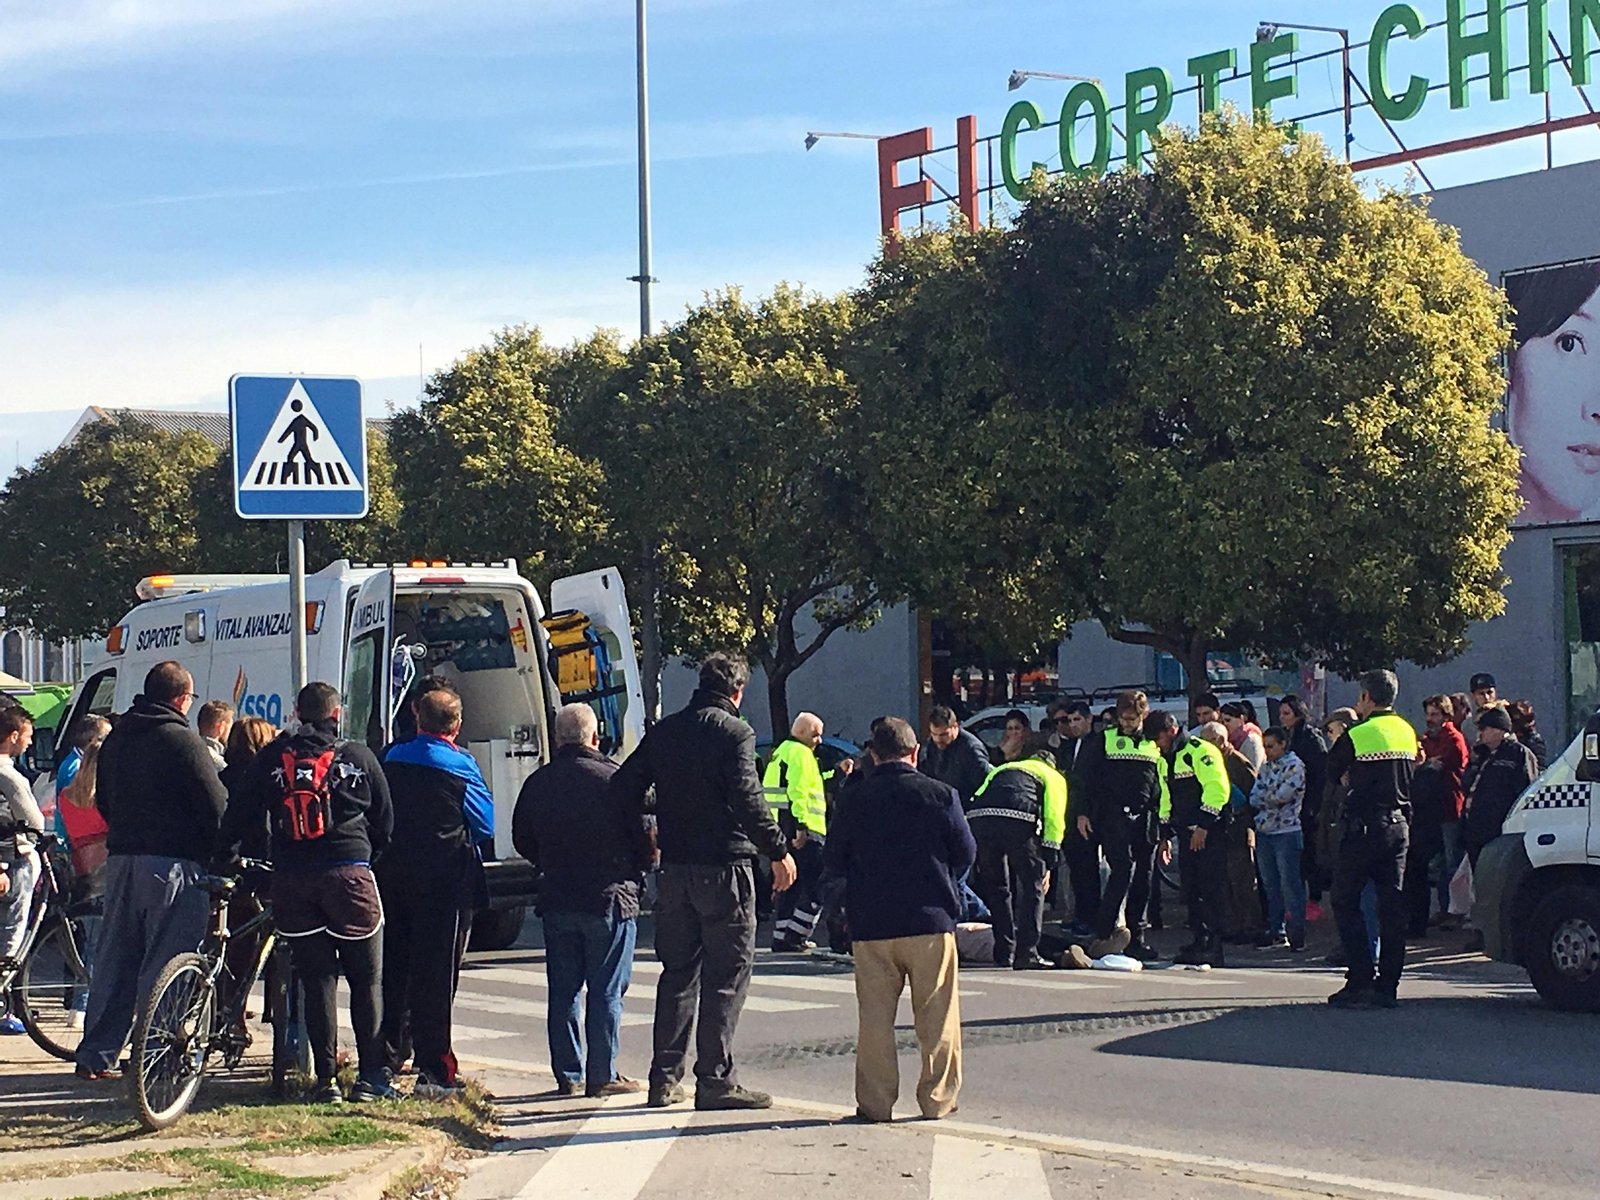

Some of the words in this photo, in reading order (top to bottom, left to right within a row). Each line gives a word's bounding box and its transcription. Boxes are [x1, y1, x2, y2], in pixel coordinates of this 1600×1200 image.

[1000, 32, 1303, 202] CORTE
[136, 624, 183, 651] SOPORTE
[215, 617, 242, 641] VITAL
[243, 611, 292, 639] AVANZAD
[353, 600, 386, 630] AMBUL
